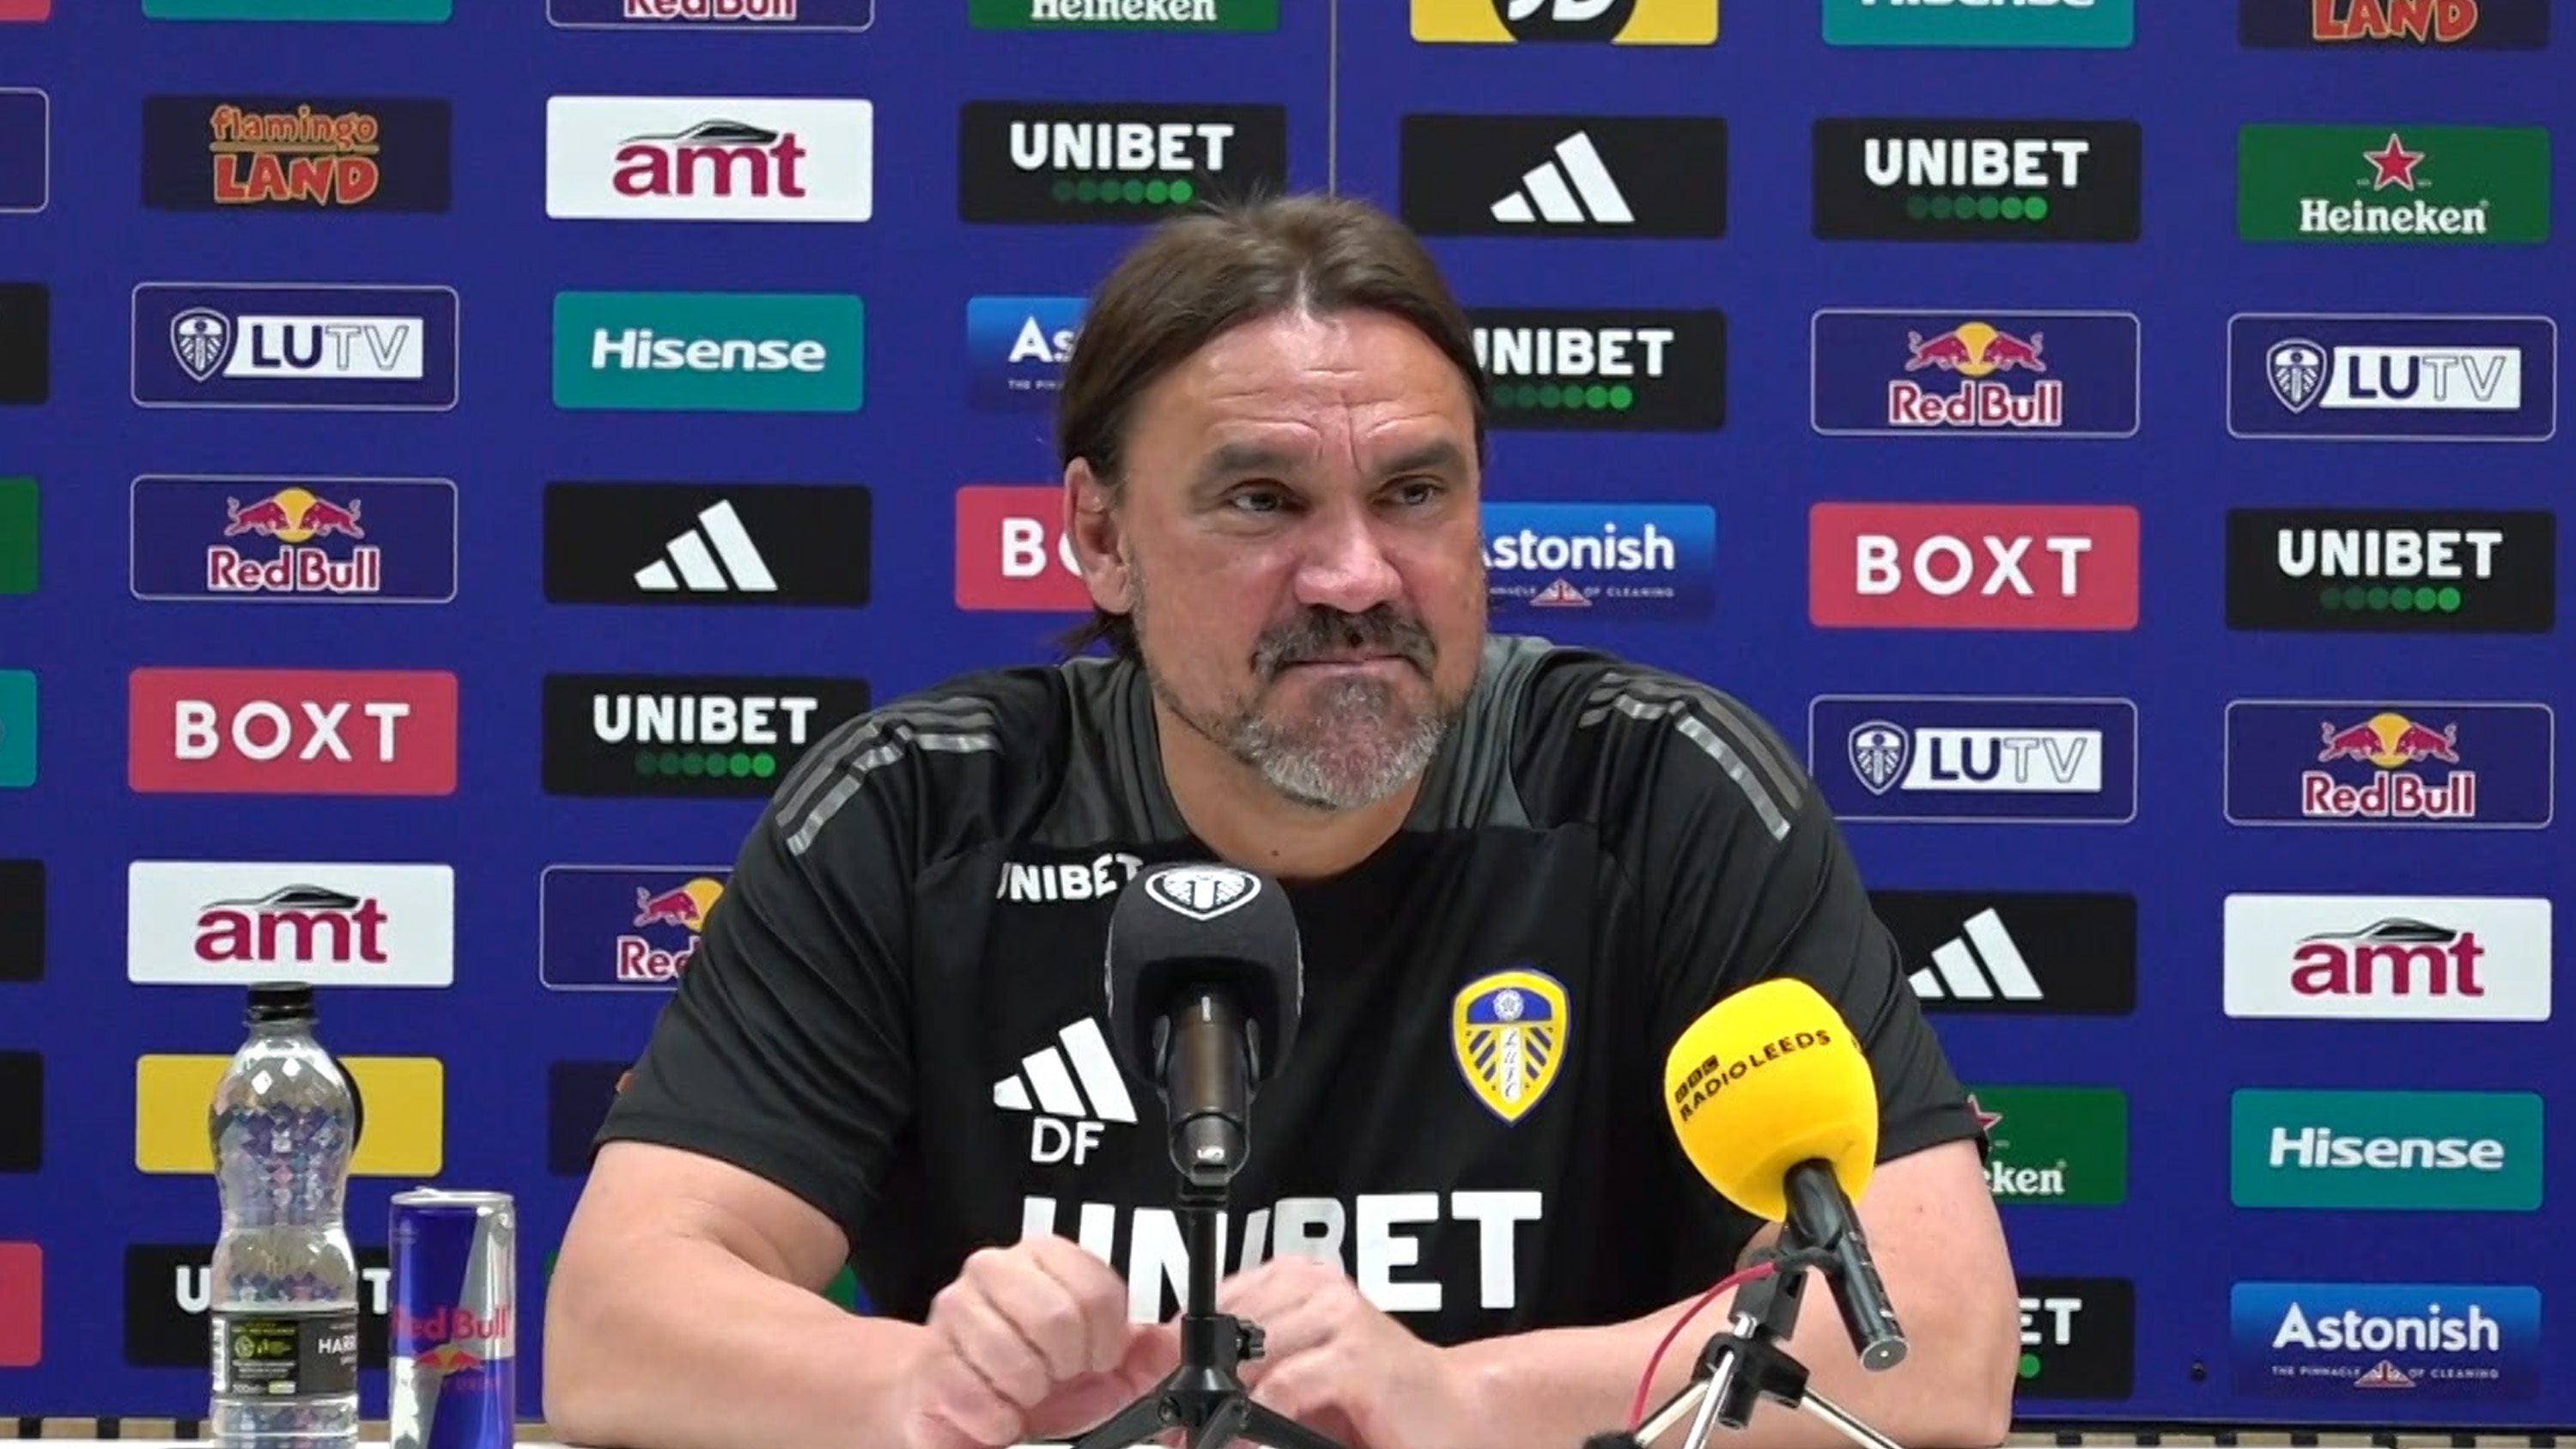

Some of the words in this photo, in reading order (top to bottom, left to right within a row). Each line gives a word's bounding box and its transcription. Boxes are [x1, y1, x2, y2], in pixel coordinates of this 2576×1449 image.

[2312, 0, 2478, 43] LAND
[210, 105, 379, 150] flamingo
[1010, 122, 1234, 172] UNIBET
[214, 153, 380, 205] LAND
[612, 131, 806, 198] amt
[1863, 137, 2089, 188] UNIBET
[2299, 198, 2488, 234] Heineken
[251, 323, 410, 372] LUTV
[592, 328, 827, 373] Hisense
[2348, 351, 2506, 400] LUTV
[1889, 380, 1977, 425] Red
[1978, 380, 2063, 428] Bull
[207, 545, 294, 591] Red
[296, 546, 380, 593] Bull
[1482, 521, 1675, 570] stonish
[1856, 533, 2093, 598] BOXT
[2277, 528, 2503, 579] UNIBET
[174, 700, 410, 762] BOXT
[592, 694, 817, 746] UNIBET
[1929, 737, 2087, 783] LUTV
[2301, 770, 2389, 817] Red
[2391, 771, 2475, 818] Bull
[194, 897, 388, 963] amt
[2290, 931, 2485, 996] amt
[1680, 1059, 1748, 1122] RADIO
[1748, 1029, 1832, 1068] LEEDS
[1030, 1117, 1106, 1166] DF
[2269, 1127, 2505, 1170] Hisense
[452, 1305, 507, 1340] Bull
[2272, 1301, 2500, 1351] Astonish
